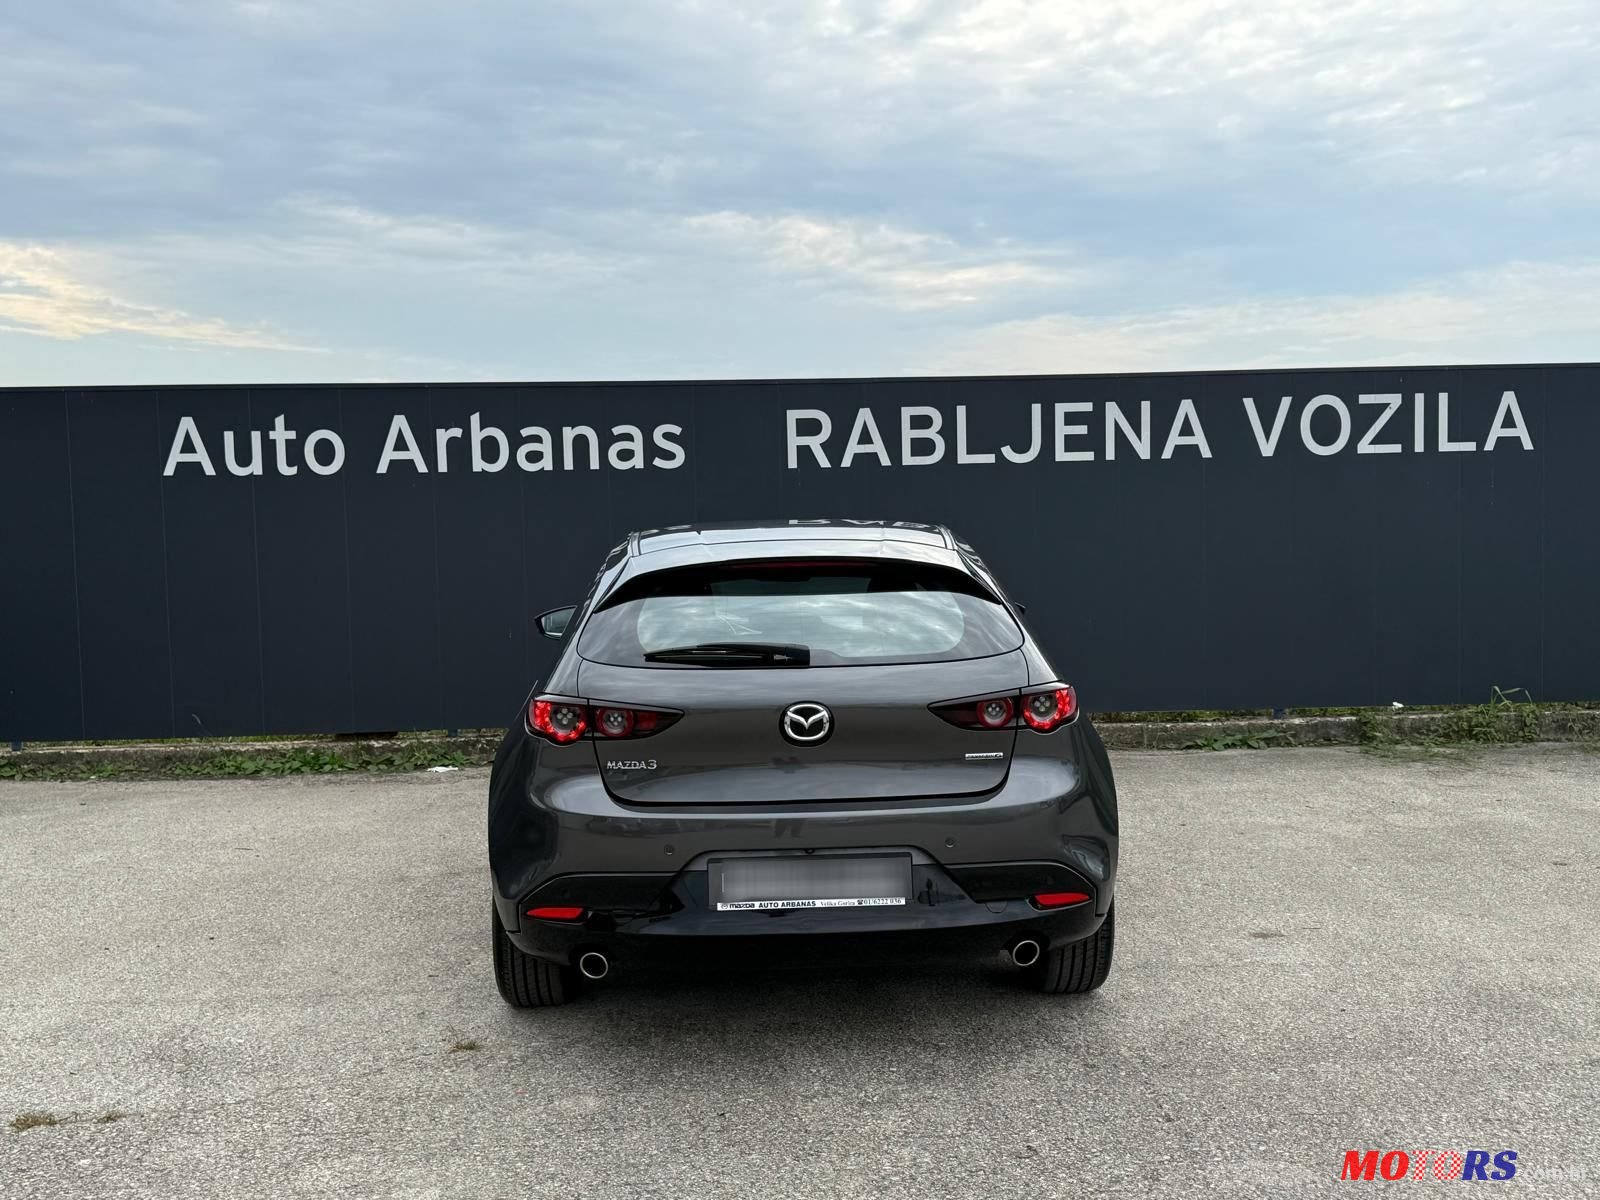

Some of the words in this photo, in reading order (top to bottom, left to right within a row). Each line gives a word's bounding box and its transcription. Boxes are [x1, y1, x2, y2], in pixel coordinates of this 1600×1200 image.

[163, 414, 345, 477] Auto
[376, 412, 686, 474] Arbanas
[786, 400, 1213, 469] RABLJENA
[1243, 391, 1534, 457] VOZILA
[781, 900, 816, 908] ARBANAS
